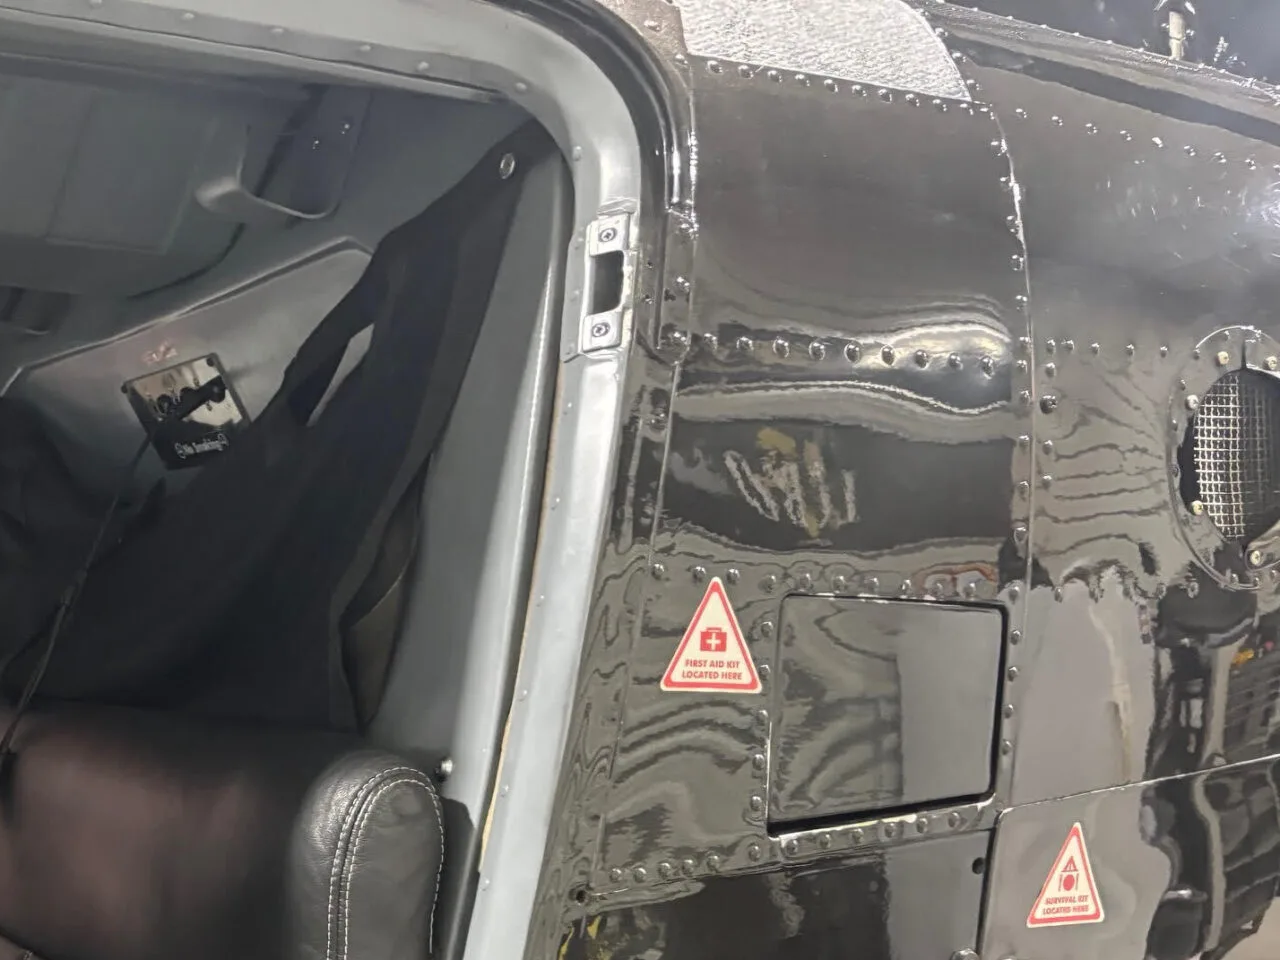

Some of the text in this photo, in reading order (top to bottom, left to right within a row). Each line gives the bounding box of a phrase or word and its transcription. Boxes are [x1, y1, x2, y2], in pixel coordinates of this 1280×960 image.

[684, 658, 741, 669] FIRST AID KIT
[682, 669, 743, 681] LOCATED HERE
[1043, 904, 1089, 915] LOCATED HERE
